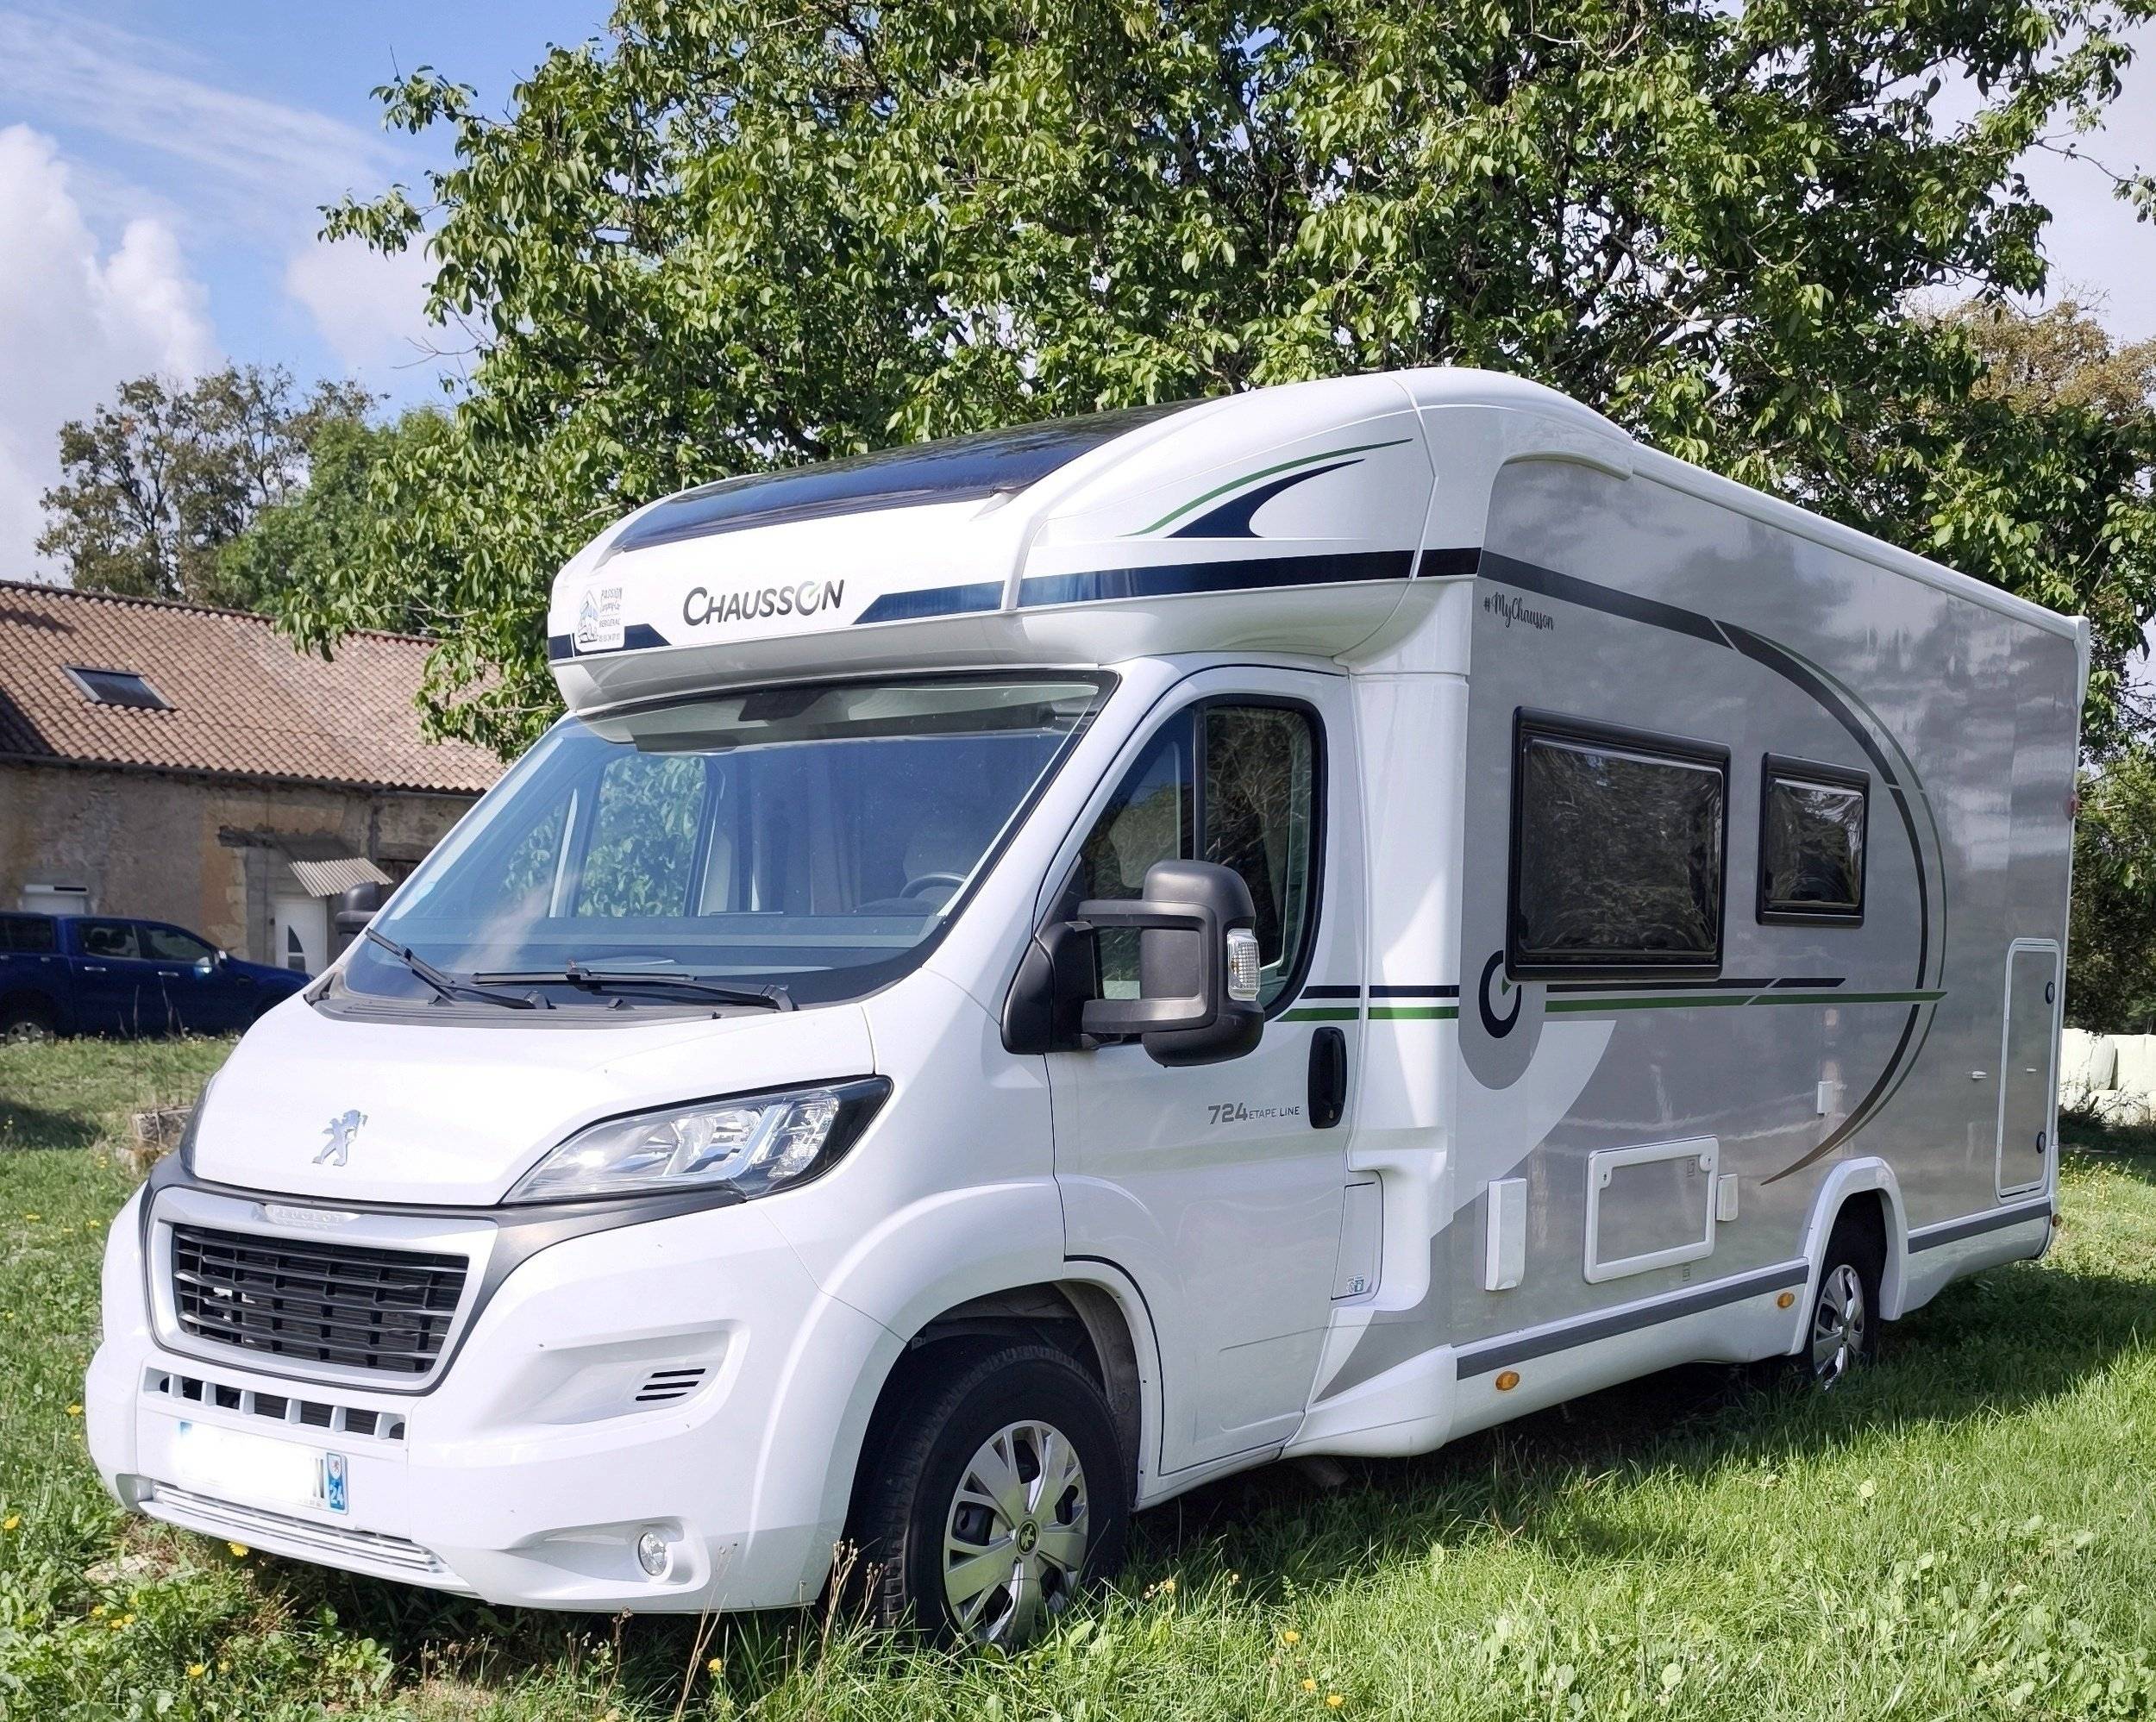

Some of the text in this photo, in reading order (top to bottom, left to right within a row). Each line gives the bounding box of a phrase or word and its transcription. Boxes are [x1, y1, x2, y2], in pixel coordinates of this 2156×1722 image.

[683, 579, 844, 626] CHAUSSON
[1483, 592, 1554, 630] #MyChausson
[1208, 1103, 1300, 1124] 724 ETAPE LINE
